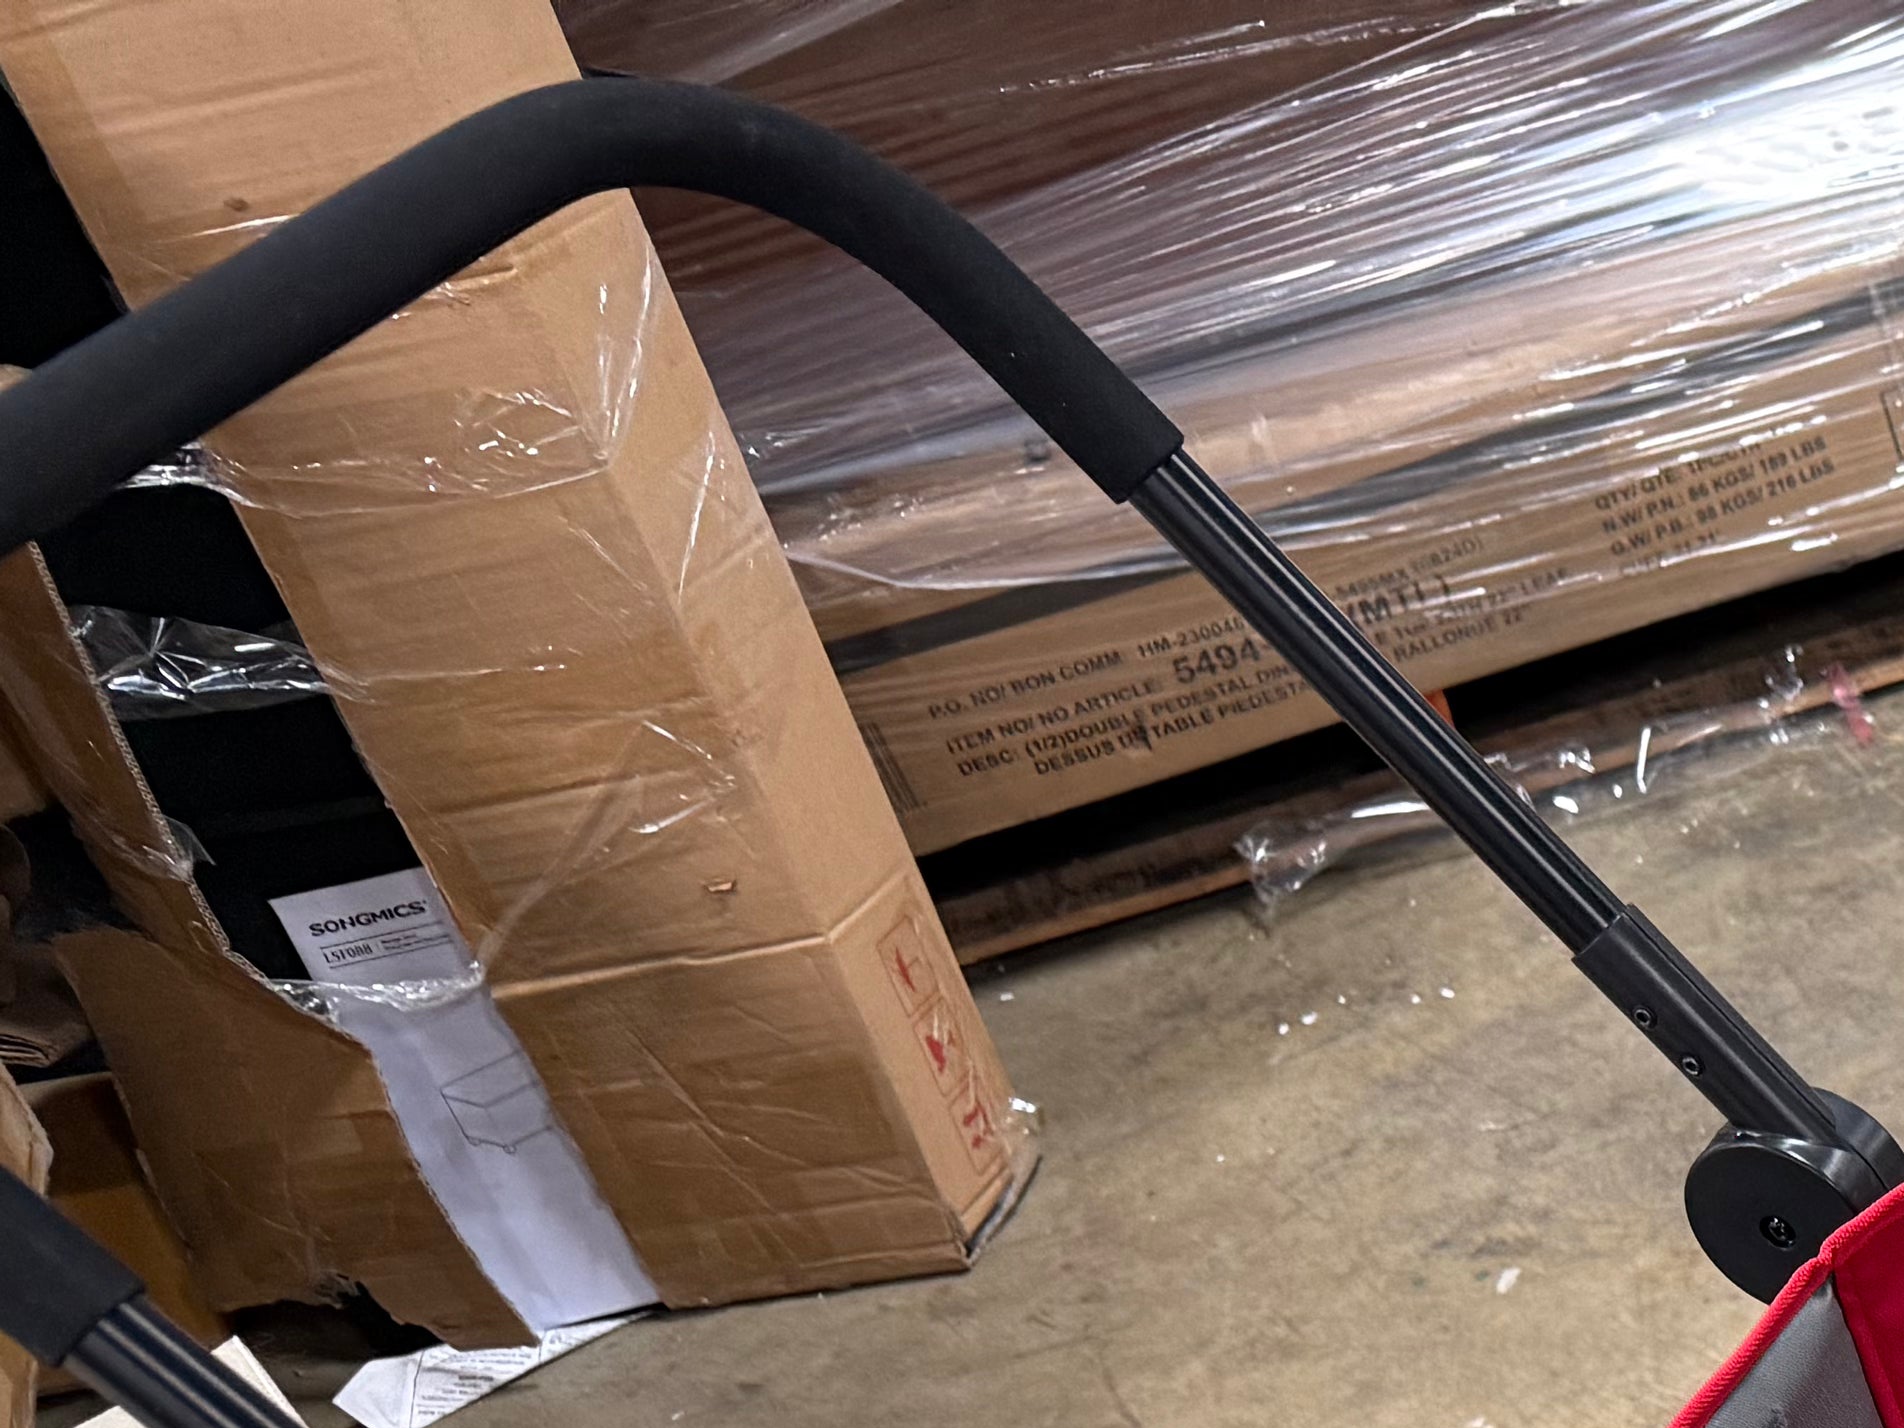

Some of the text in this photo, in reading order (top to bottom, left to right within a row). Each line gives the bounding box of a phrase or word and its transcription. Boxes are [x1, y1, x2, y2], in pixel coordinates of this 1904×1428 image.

[1712, 466, 1756, 493] KGS/
[1791, 435, 1827, 459] LBS
[1722, 486, 1763, 513] KGS/
[1768, 474, 1796, 497] 216
[1799, 459, 1835, 484] LBS
[1011, 670, 1055, 695] BON
[1137, 615, 1245, 659] HM-230046
[948, 729, 995, 754] ITEM
[1039, 707, 1070, 728] NO
[1173, 637, 1274, 684] 5494-
[1151, 677, 1252, 718] PEDESTAL
[1256, 662, 1294, 687] DIN
[1035, 737, 1116, 775] DESSUS
[1153, 703, 1215, 737] TABLE
[309, 901, 426, 937] SONGMICS
